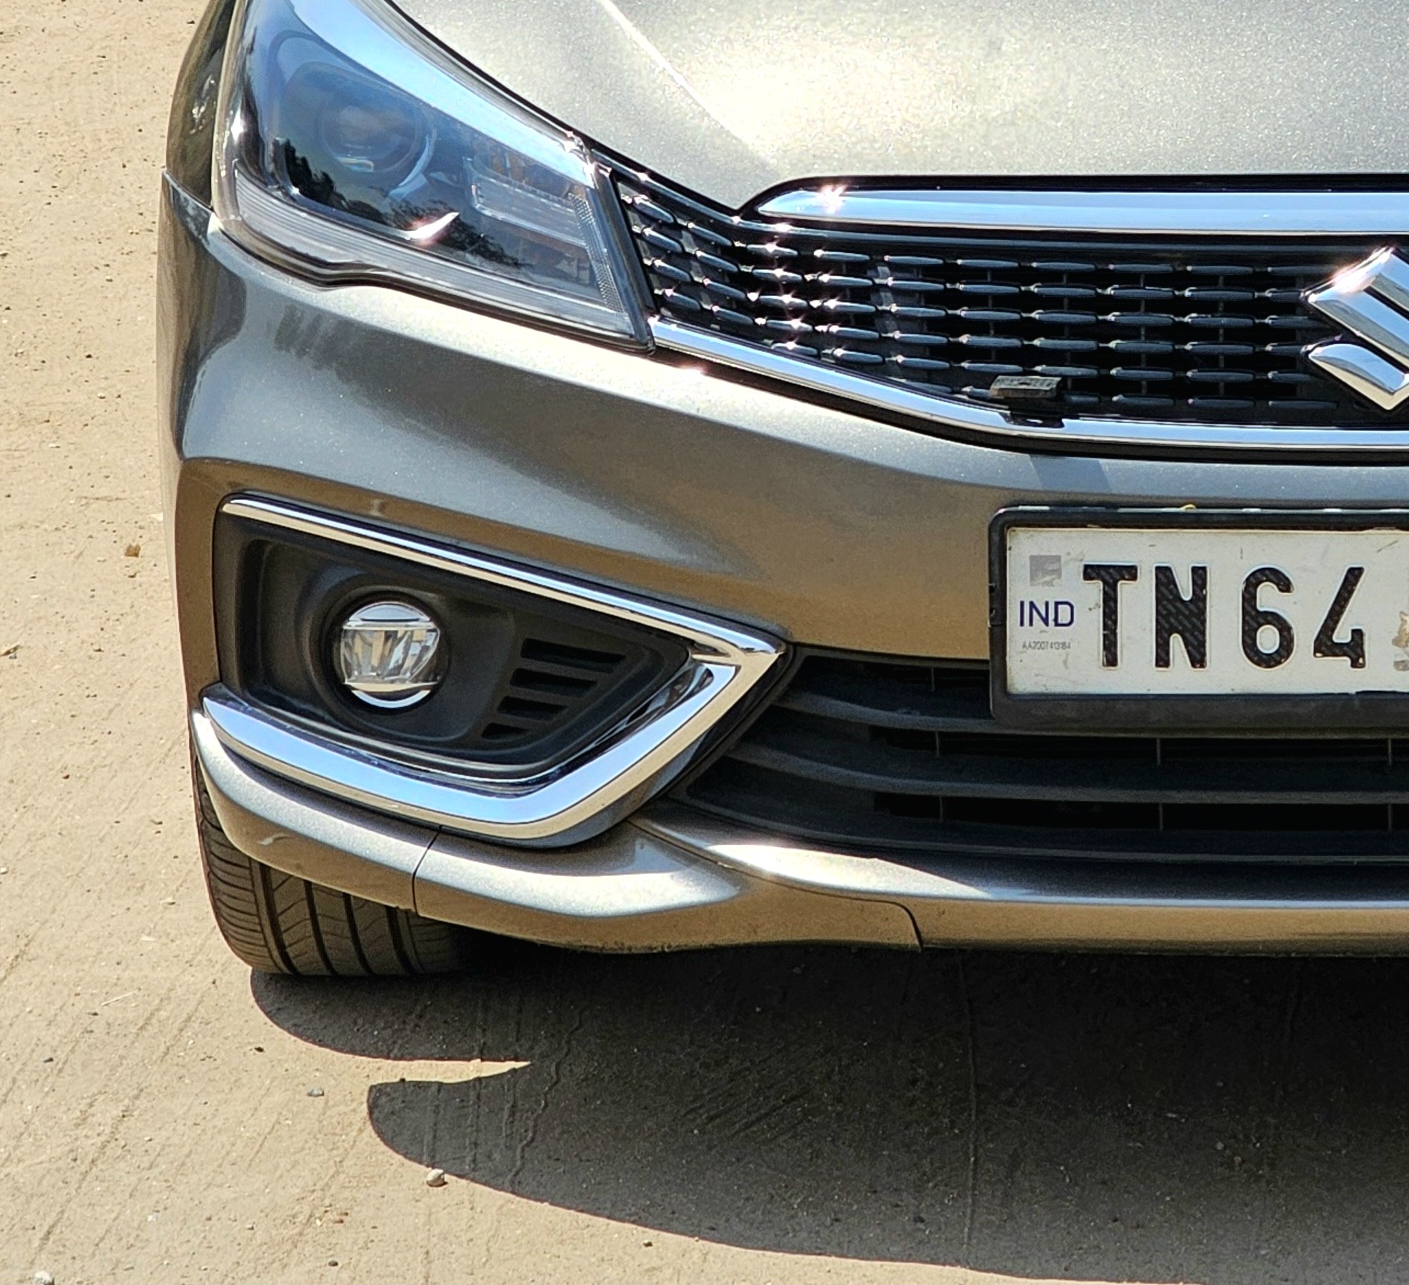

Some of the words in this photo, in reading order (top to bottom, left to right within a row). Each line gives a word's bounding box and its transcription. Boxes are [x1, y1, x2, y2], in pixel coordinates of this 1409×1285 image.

[1019, 600, 1075, 627] IND
[1082, 564, 1208, 669] TN
[1240, 563, 1366, 668] 64
